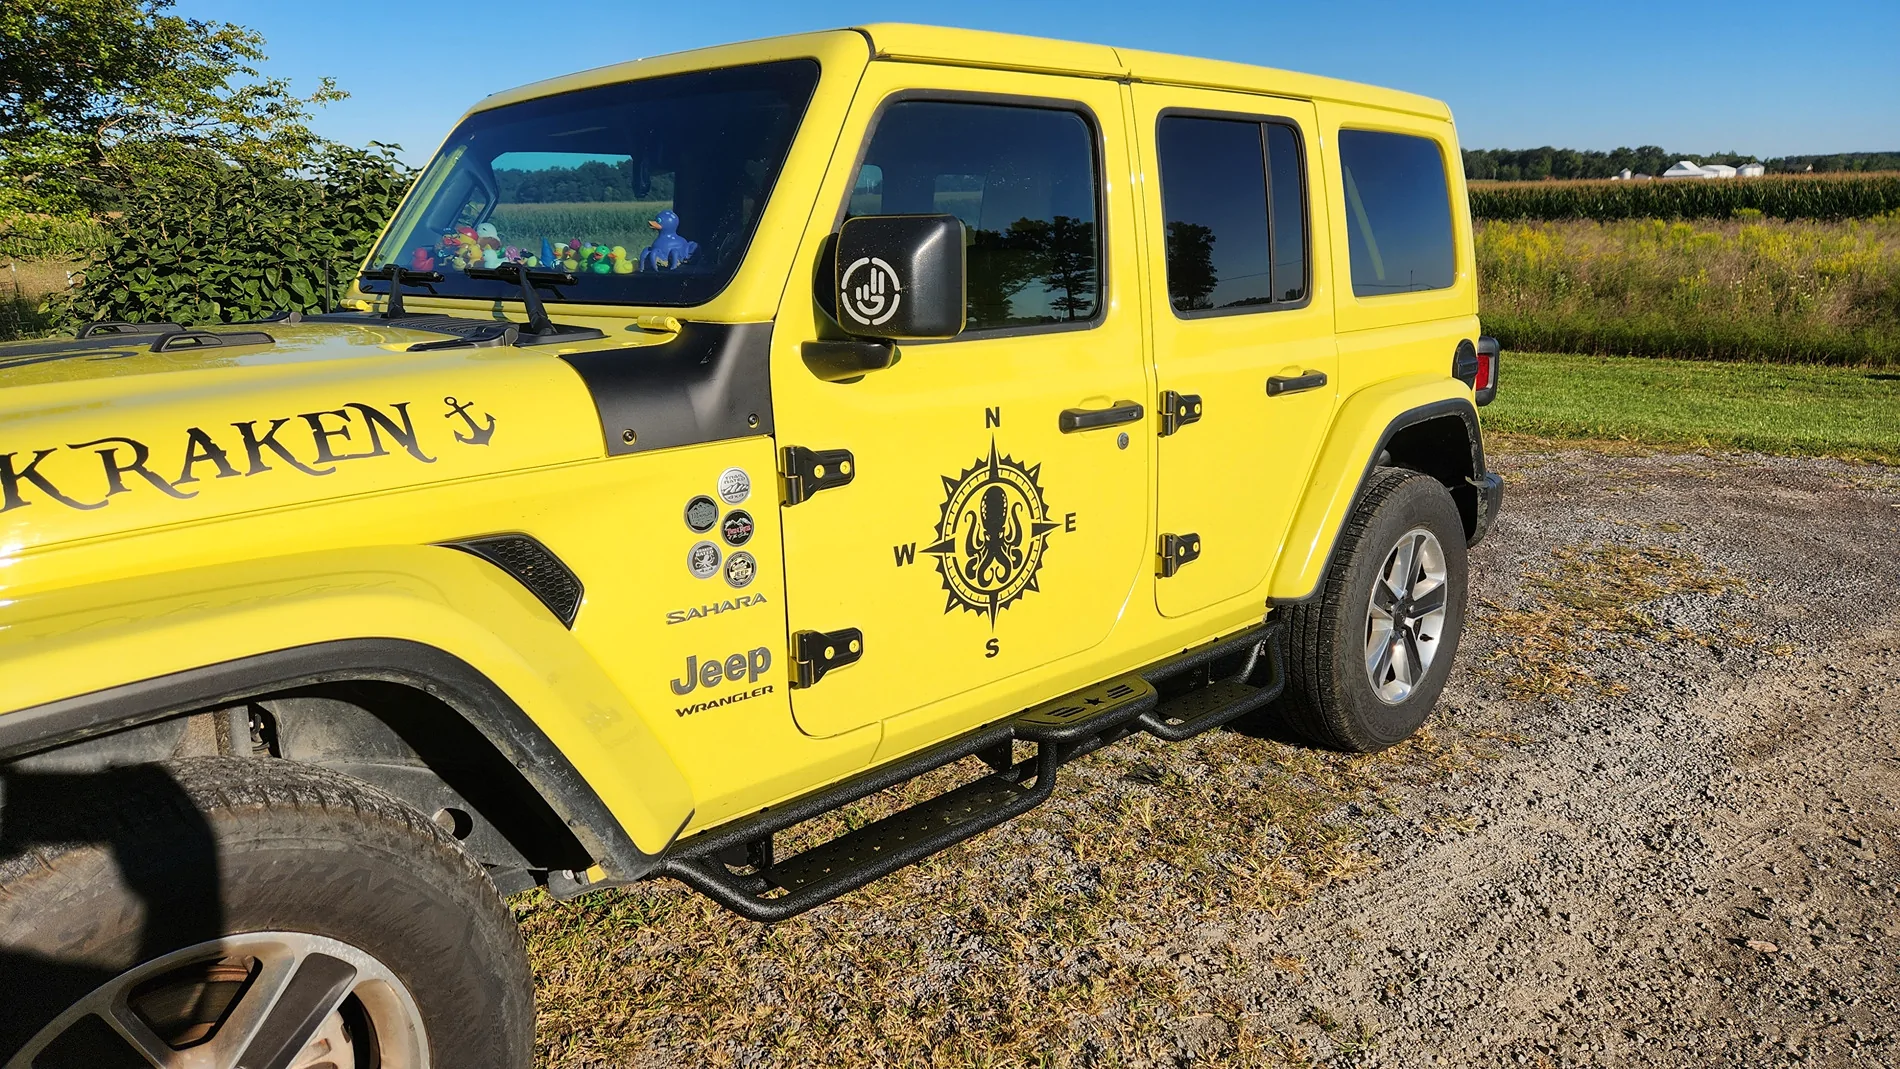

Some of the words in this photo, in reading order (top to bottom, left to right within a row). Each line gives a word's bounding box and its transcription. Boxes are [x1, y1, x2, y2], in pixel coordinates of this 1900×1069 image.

[985, 406, 1001, 428] N
[0, 402, 437, 512] KRAKEN
[1065, 512, 1077, 533] E
[893, 542, 916, 567] W
[665, 593, 768, 625] SAHARA
[985, 638, 1000, 659] S
[669, 646, 772, 696] Jeep
[675, 685, 774, 718] WRANGLER
